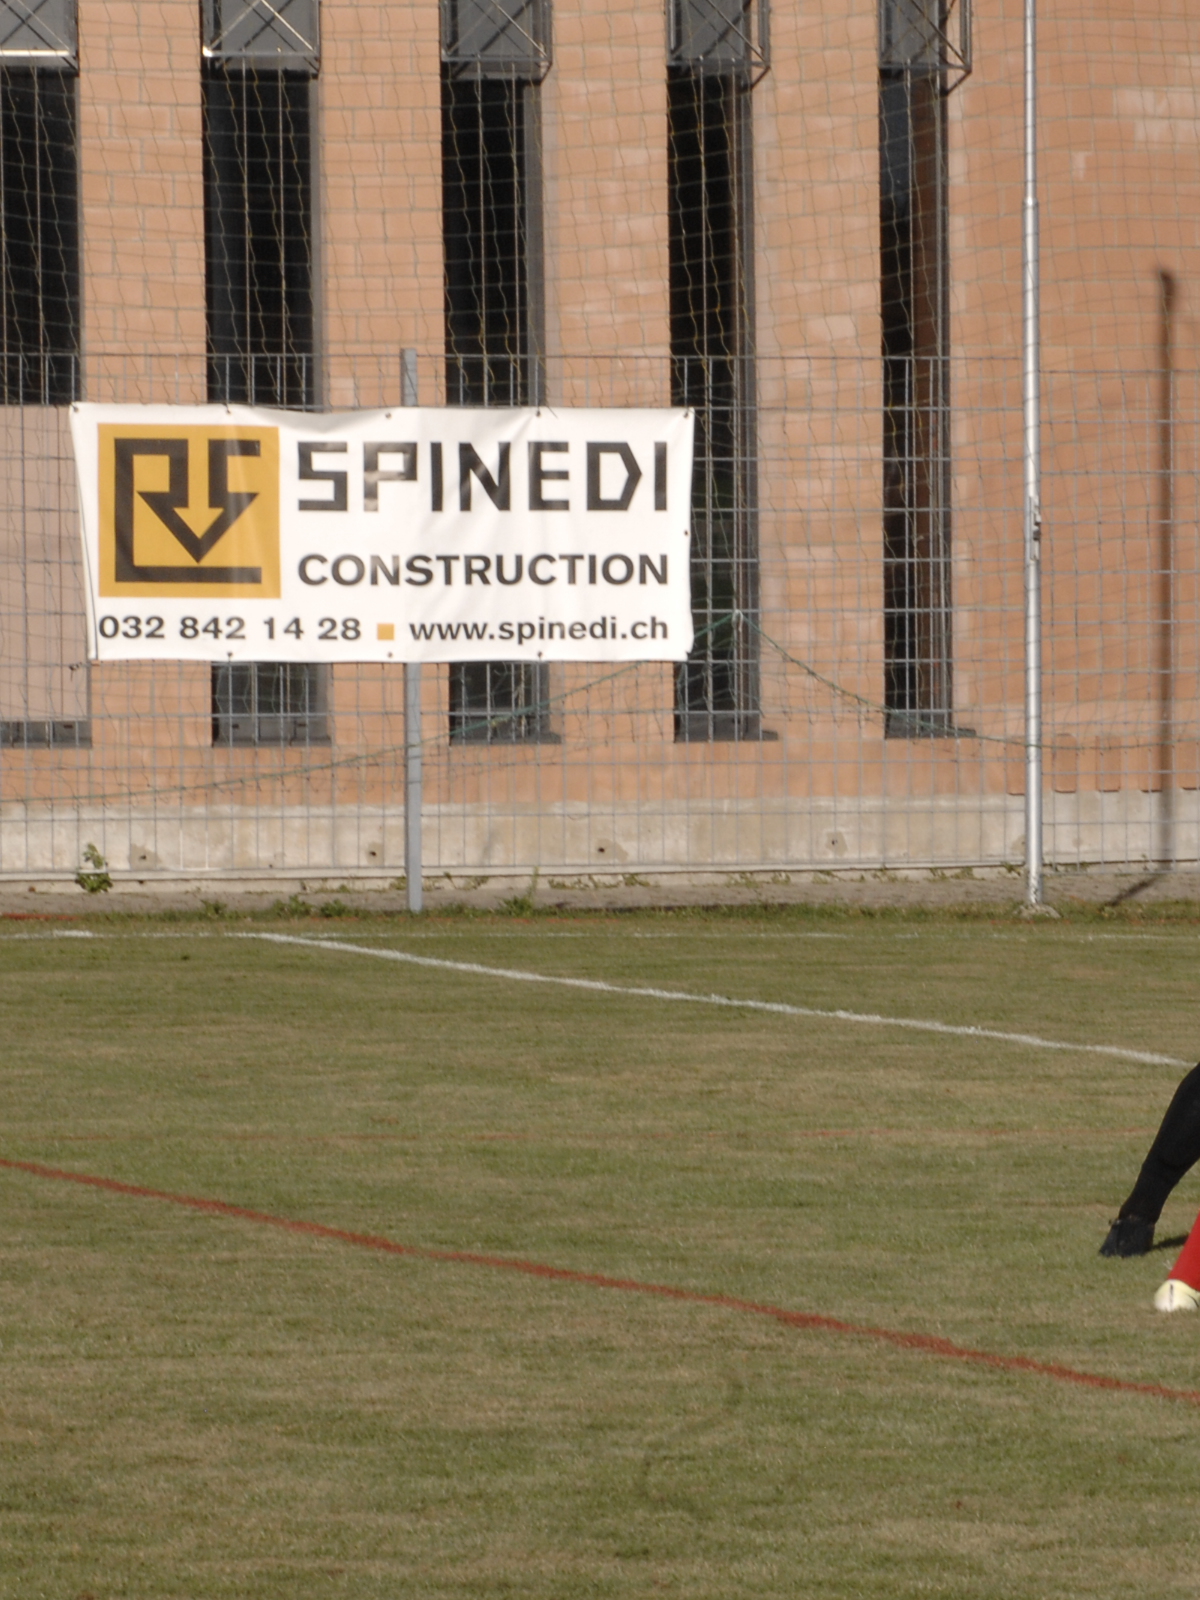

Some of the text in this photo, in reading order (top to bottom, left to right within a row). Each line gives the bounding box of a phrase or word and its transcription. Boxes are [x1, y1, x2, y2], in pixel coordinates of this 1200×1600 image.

[297, 441, 669, 512] SPINEDI
[298, 553, 669, 587] CONSTRUCTION
[98, 615, 669, 645] 032 842 14 28 www.spinedi.ch
